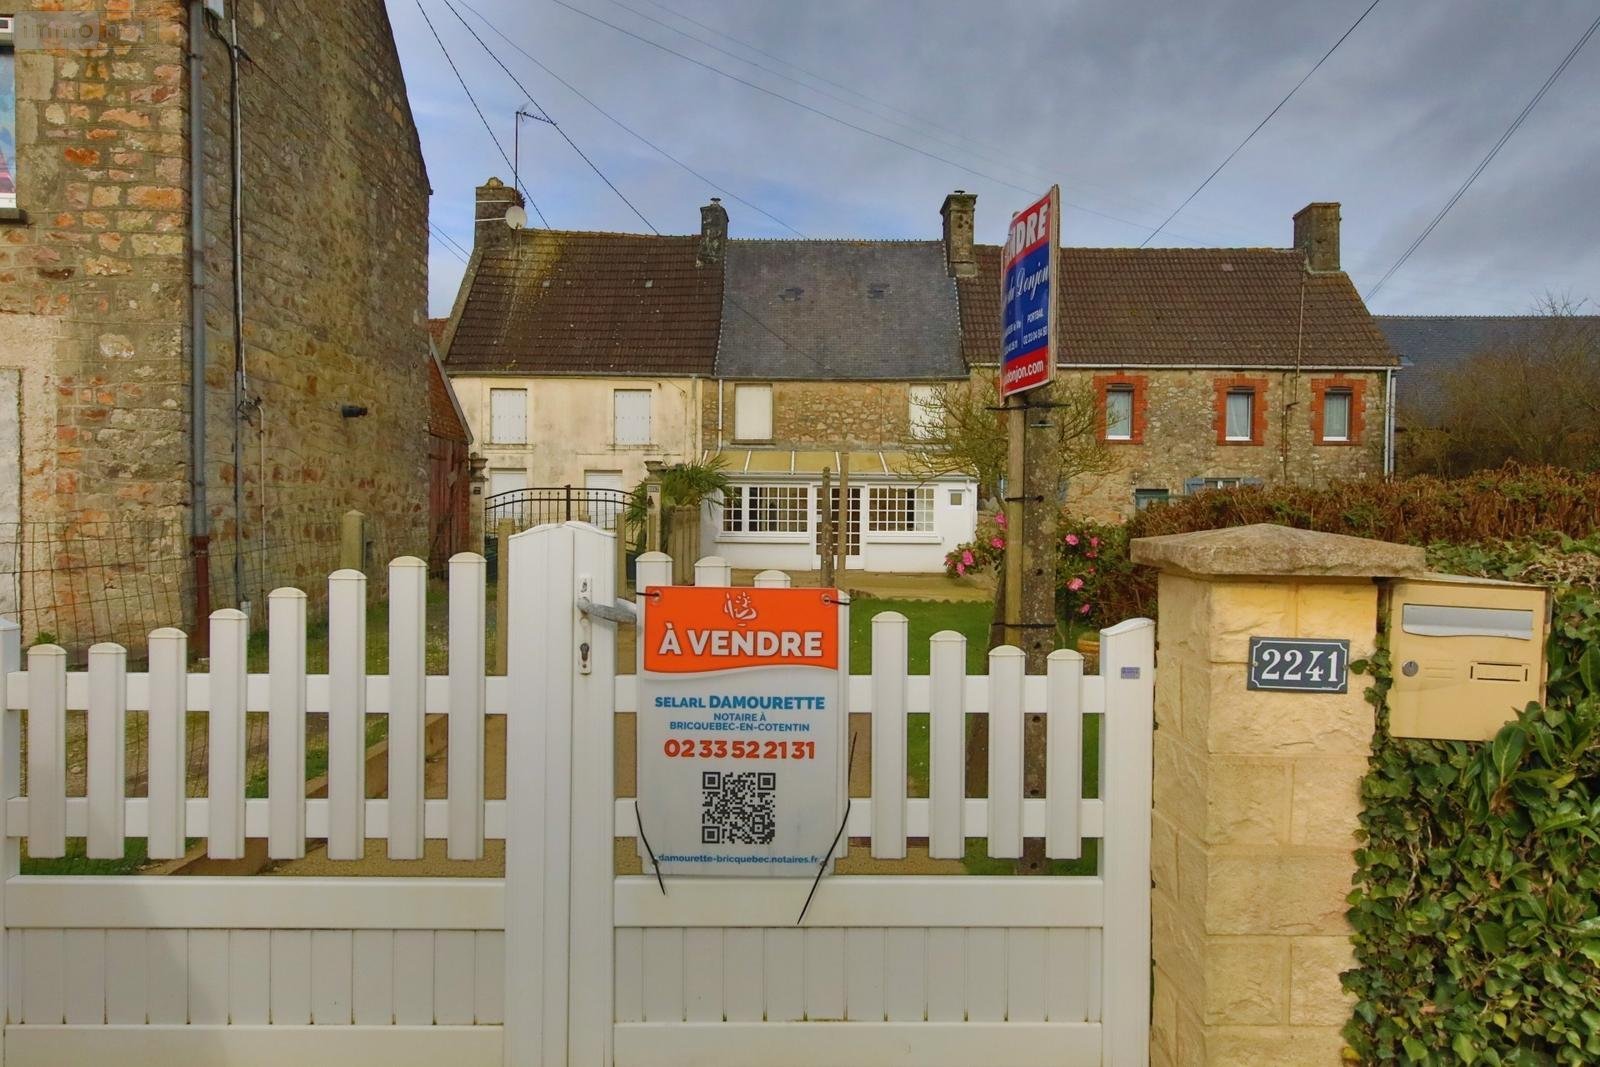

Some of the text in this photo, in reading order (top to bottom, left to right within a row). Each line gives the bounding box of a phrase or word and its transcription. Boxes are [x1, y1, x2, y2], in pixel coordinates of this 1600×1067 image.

[659, 622, 823, 657] À VENDRE
[1261, 649, 1338, 682] 2241
[655, 695, 825, 710] SELARL DAMOURETTE
[713, 711, 766, 722] NOTAIRE À
[670, 721, 810, 732] BRICQUEBEC-EN-COTENTIN
[664, 739, 815, 759] 02 33 52 21 31
[658, 854, 818, 865] damourette-bricquebec.notaires.fr
